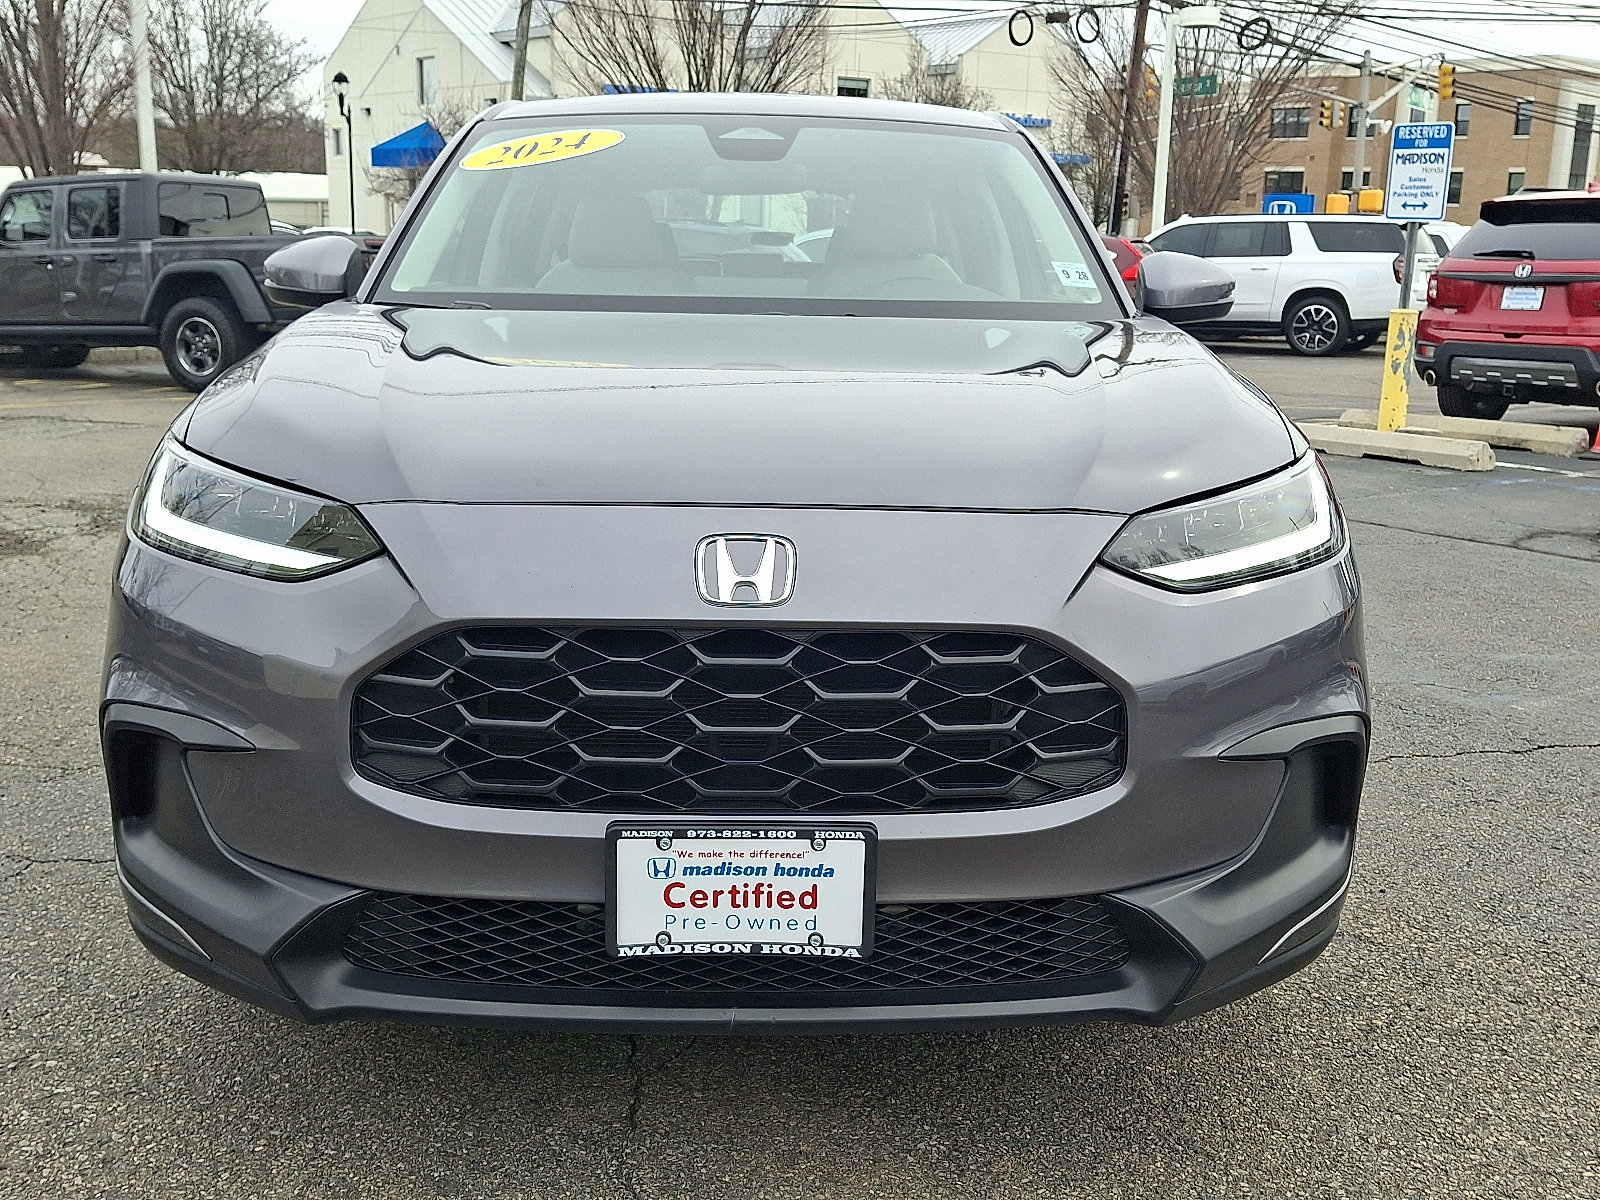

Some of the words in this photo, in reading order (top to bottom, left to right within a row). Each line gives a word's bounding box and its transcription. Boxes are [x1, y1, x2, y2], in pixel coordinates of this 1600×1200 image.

[1398, 125, 1448, 139] RESERVED
[486, 132, 592, 166] 2024
[1414, 138, 1429, 148] FOR
[1395, 153, 1445, 165] MADISON
[1061, 269, 1071, 279] 9
[1075, 270, 1089, 281] 28
[621, 830, 673, 838] MADISON
[686, 830, 797, 838] 973-822-1600
[814, 831, 866, 839] HONDA
[698, 850, 724, 858] make
[728, 850, 745, 858] the
[682, 862, 767, 876] madison
[773, 863, 835, 877] honda
[663, 882, 818, 909] Certified
[665, 914, 817, 931] Pre-Owned
[617, 943, 753, 957] MADISON
[760, 944, 862, 958] HONDA
